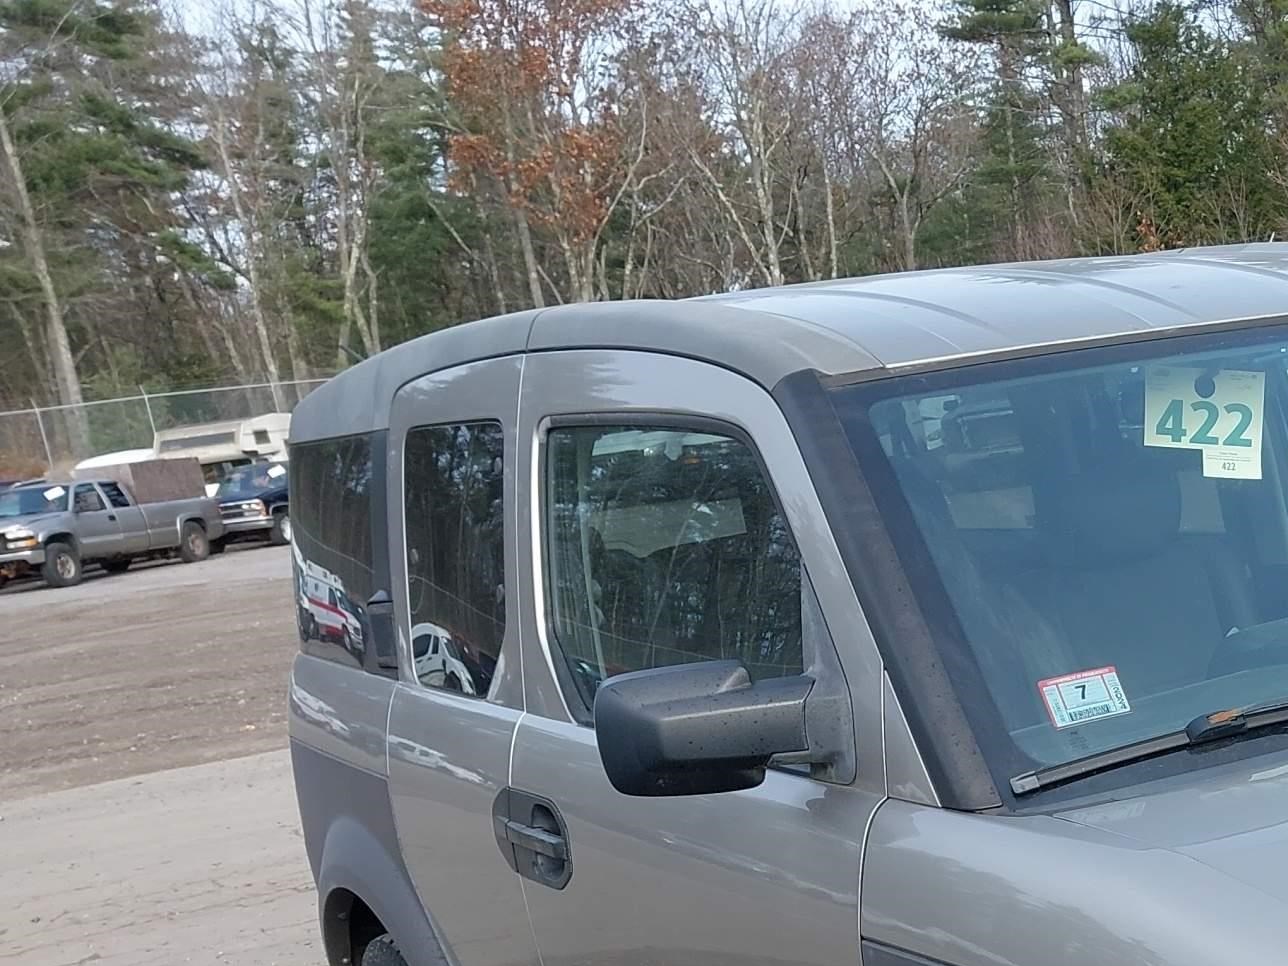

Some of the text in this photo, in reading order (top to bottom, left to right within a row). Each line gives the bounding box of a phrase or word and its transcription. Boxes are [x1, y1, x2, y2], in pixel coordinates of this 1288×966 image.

[1155, 399, 1253, 448] 422
[1221, 462, 1237, 471] 422
[1074, 684, 1086, 700] 7
